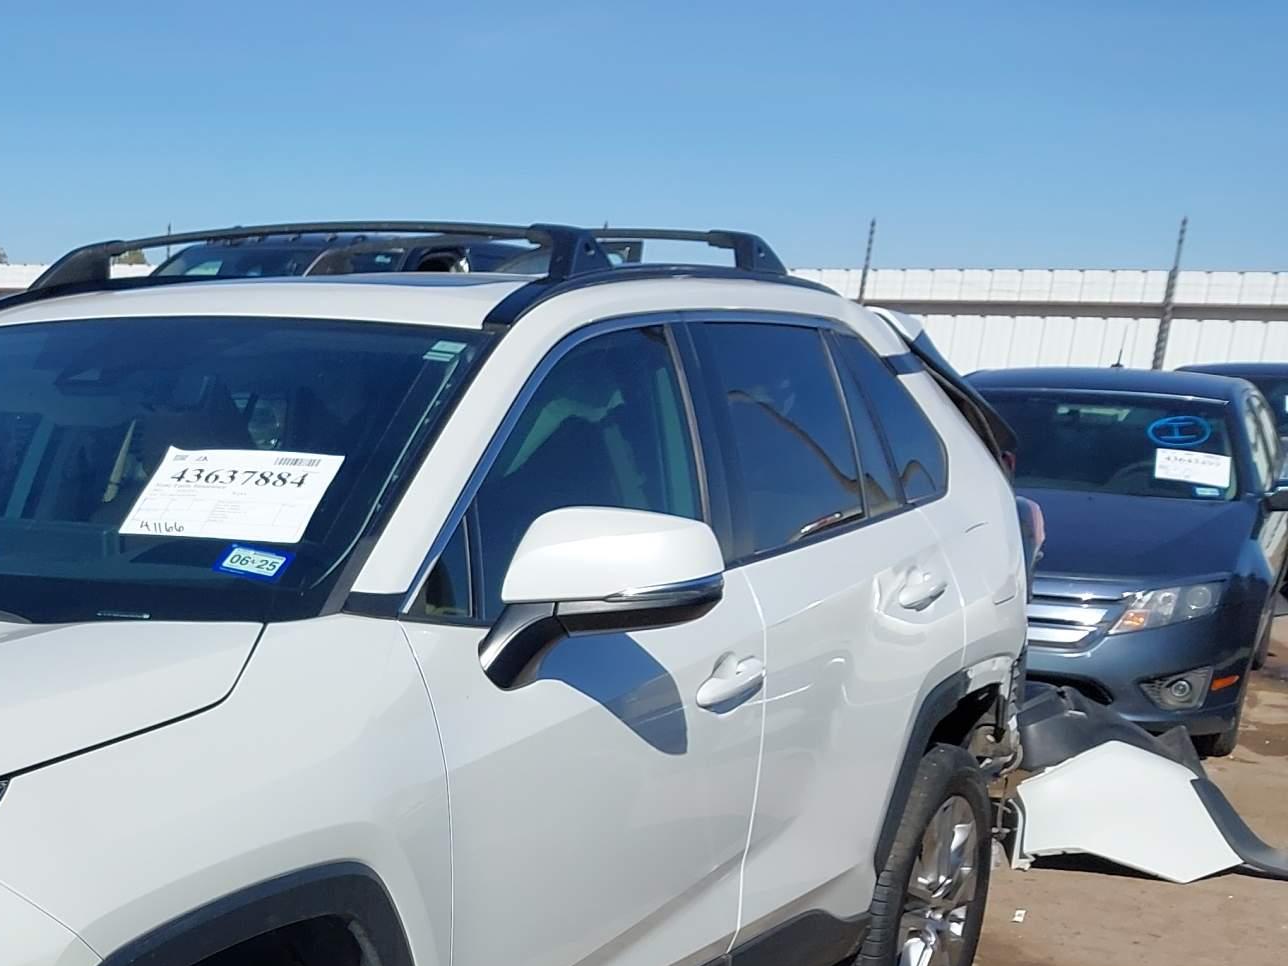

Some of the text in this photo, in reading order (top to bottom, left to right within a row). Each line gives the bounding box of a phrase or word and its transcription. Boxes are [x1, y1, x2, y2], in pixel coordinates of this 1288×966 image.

[170, 467, 310, 488] 43637884
[229, 553, 281, 573] 06 25
